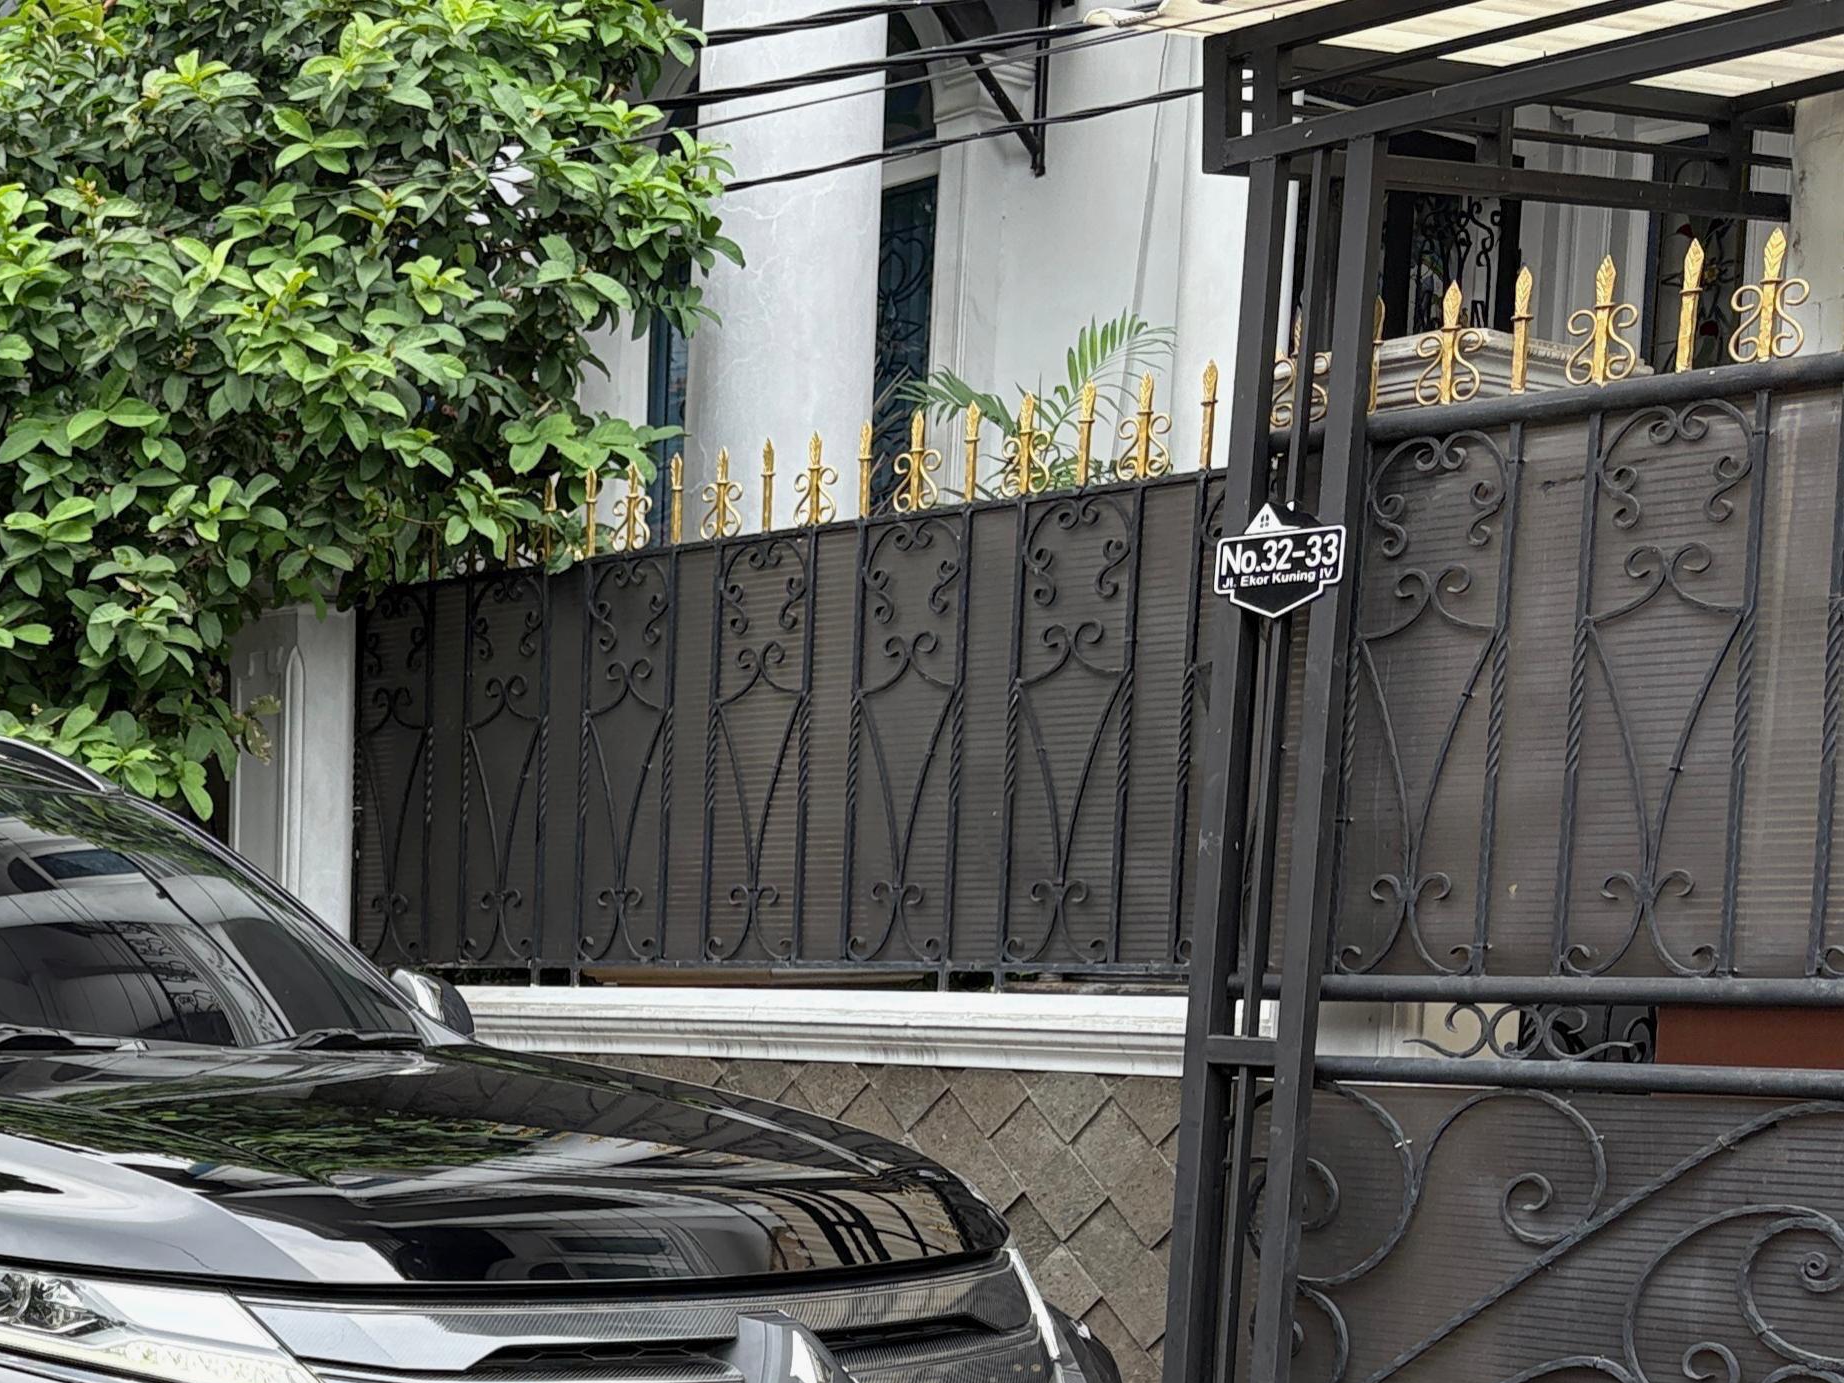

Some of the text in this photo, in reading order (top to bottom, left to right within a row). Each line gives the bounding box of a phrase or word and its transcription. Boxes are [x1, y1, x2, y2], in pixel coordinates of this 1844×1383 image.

[1221, 533, 1338, 576] No.32-33
[1240, 574, 1270, 588] Ekor
[1272, 569, 1316, 585] Kuning
[1319, 567, 1334, 579] IV
